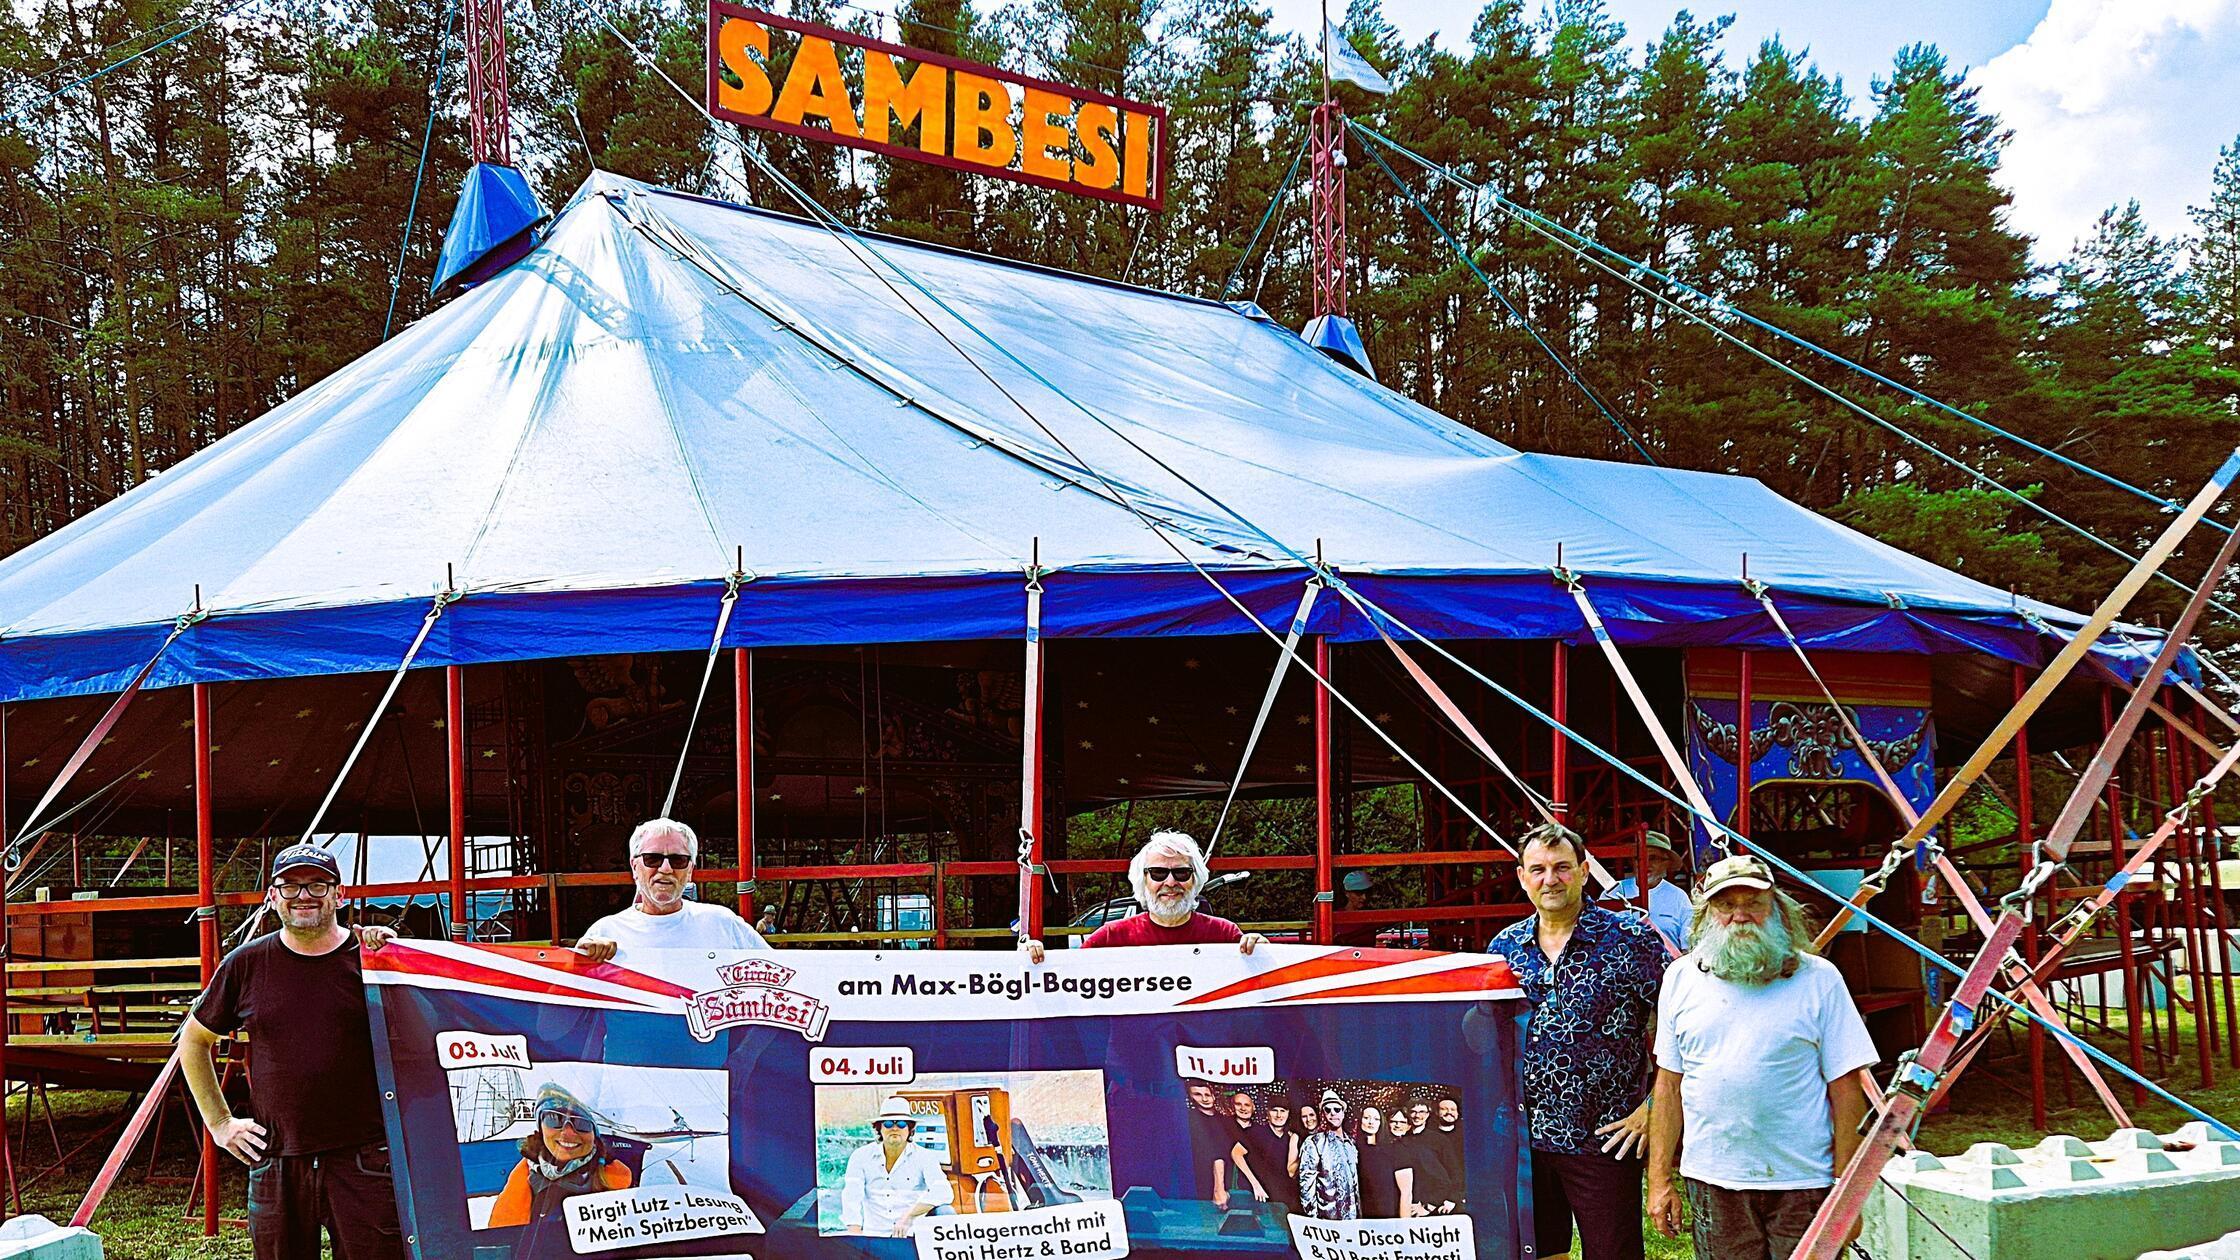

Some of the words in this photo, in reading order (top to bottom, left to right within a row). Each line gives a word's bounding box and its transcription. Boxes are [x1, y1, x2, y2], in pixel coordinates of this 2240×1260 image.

[718, 18, 1149, 197] SAMBESI
[732, 966, 781, 984] Circus
[838, 976, 882, 995] am
[891, 972, 1193, 1000] Max-Bögl-Baggersee
[705, 993, 809, 1024] Sambesi
[449, 1041, 486, 1060] 03.
[491, 1043, 521, 1061] Juli
[820, 1058, 858, 1075] 04.
[865, 1056, 903, 1075] Juli
[1188, 1056, 1213, 1075] 11.
[1219, 1057, 1257, 1076] Juli
[910, 1100, 941, 1115] OGAS
[578, 1202, 627, 1223] Birgit
[631, 1198, 670, 1214] Lutz
[685, 1193, 743, 1214] Lesung
[933, 1216, 1070, 1242] Schlagernacht
[1077, 1211, 1106, 1230] mit
[1302, 1225, 1340, 1244] 4TUP
[1359, 1229, 1404, 1246] Disco
[1409, 1225, 1461, 1248] Night
[933, 1245, 974, 1260] Toni
[980, 1244, 1034, 1260] Hertz
[1040, 1240, 1055, 1256] &
[1060, 1233, 1111, 1255] Band
[1311, 1245, 1325, 1260] &
